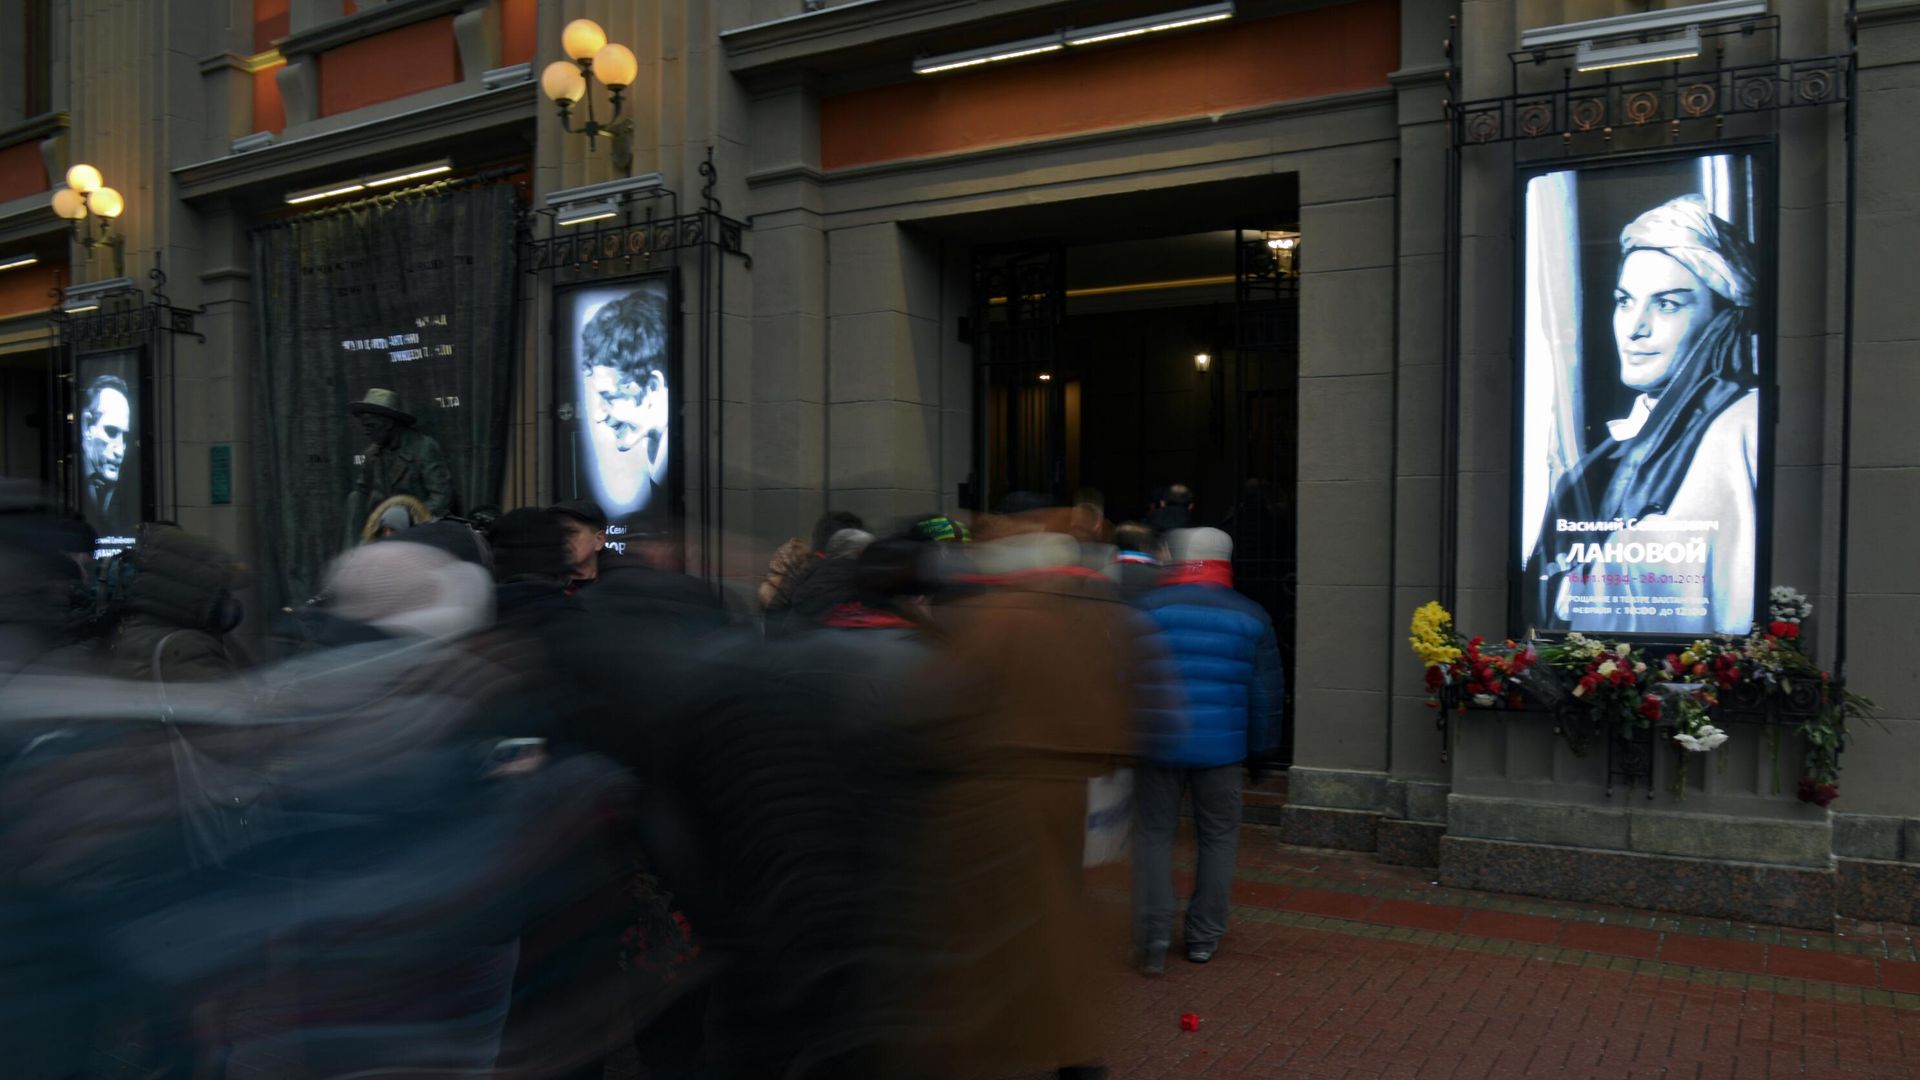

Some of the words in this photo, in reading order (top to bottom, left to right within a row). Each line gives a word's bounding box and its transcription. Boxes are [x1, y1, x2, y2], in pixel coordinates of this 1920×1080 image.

[1556, 518, 1624, 532] Василий
[1567, 537, 1706, 563] ЛАНОВОЙ
[1639, 572, 1707, 584] 28.01.2021
